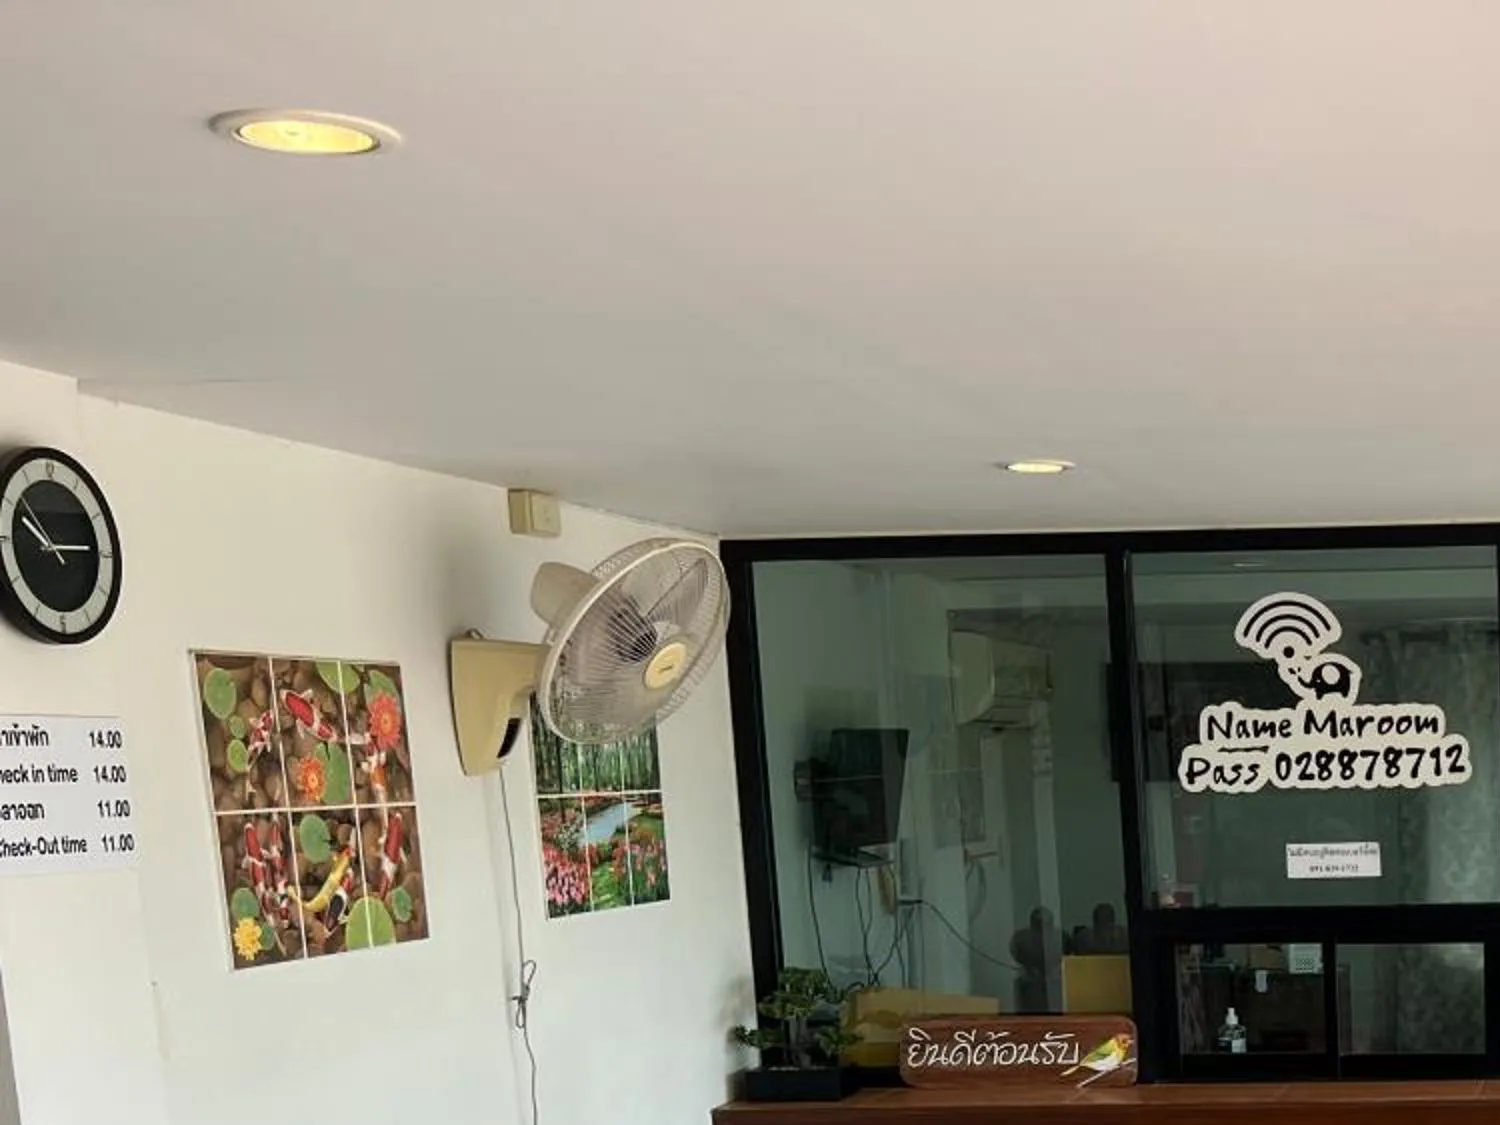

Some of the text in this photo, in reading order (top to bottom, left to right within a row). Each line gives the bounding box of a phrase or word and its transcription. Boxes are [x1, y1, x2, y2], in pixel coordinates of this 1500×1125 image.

[1207, 709, 1439, 741] Name Maroom
[89, 730, 122, 748] 14.00
[31, 763, 45, 783] in
[47, 764, 78, 783] time
[93, 765, 127, 783] 14.00
[1186, 744, 1467, 785] Pass 028878712
[97, 799, 131, 817] 11.00
[61, 836, 88, 853] time
[101, 834, 135, 851] 11.00
[907, 1027, 1080, 1068] ยินดีต้อนรับ
